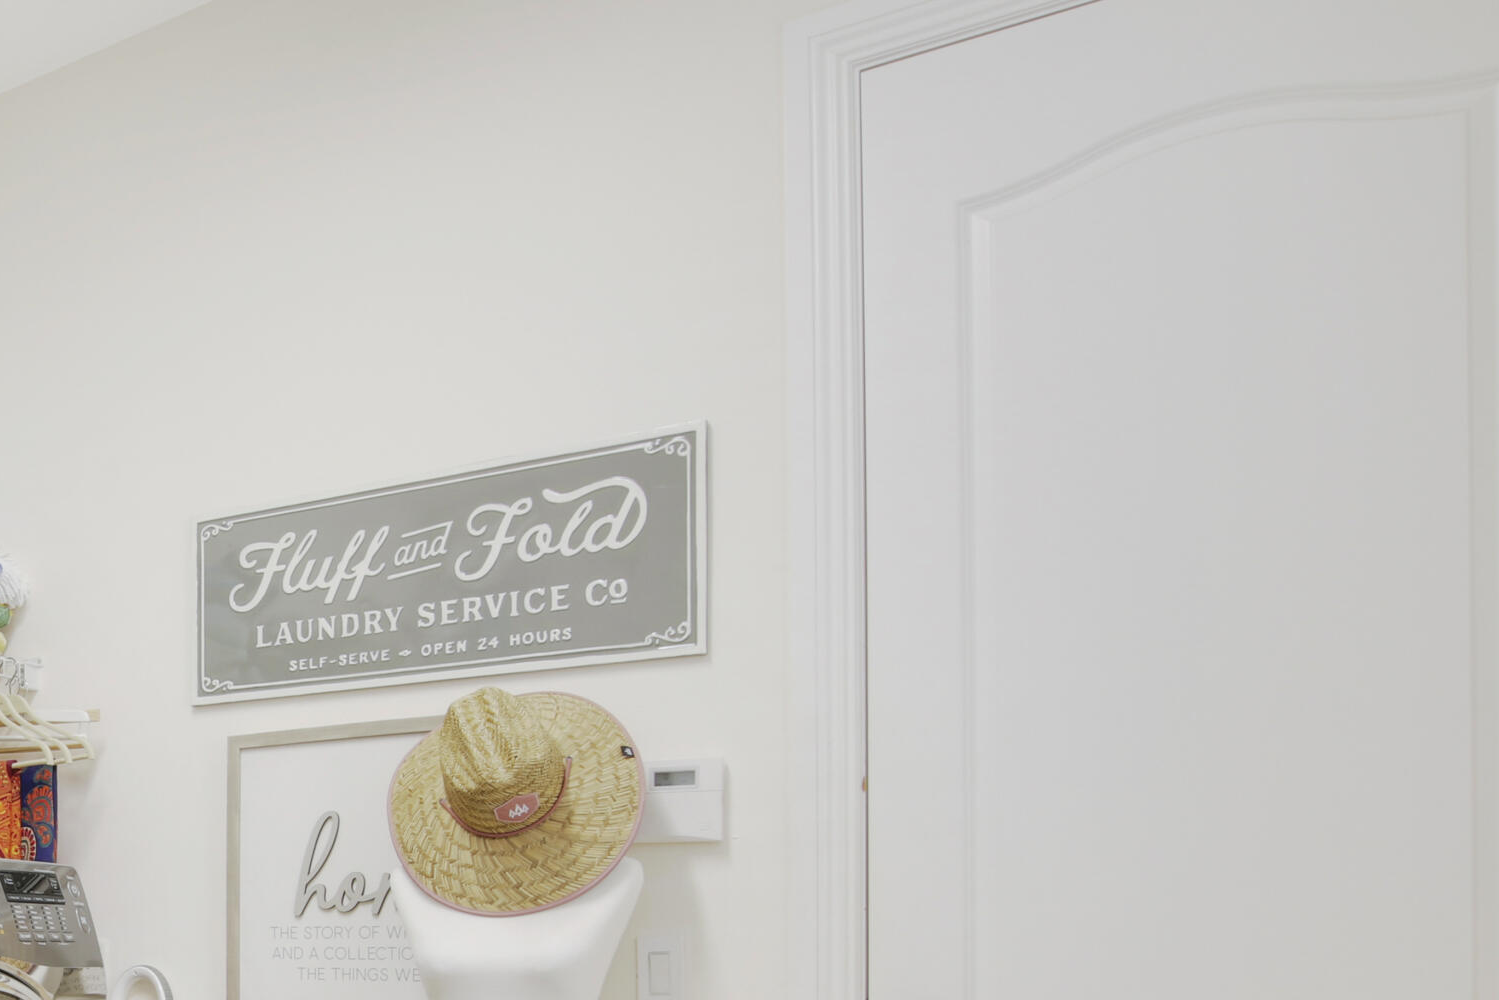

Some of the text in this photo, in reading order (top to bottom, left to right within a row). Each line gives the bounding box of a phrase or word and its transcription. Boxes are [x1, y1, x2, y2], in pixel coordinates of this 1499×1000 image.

[229, 476, 648, 612] Fluff and Fold
[256, 606, 404, 648] LAUNDRY
[417, 584, 570, 628] SERVICE
[289, 627, 572, 672] SELF-SERVE OPEN 24 HOURS
[270, 926, 298, 939] THE
[304, 926, 353, 939] STORY
[358, 925, 380, 939] OF
[272, 946, 303, 960] AND
[309, 946, 320, 960] A
[297, 967, 325, 981] THE
[331, 967, 389, 981] THINGS
